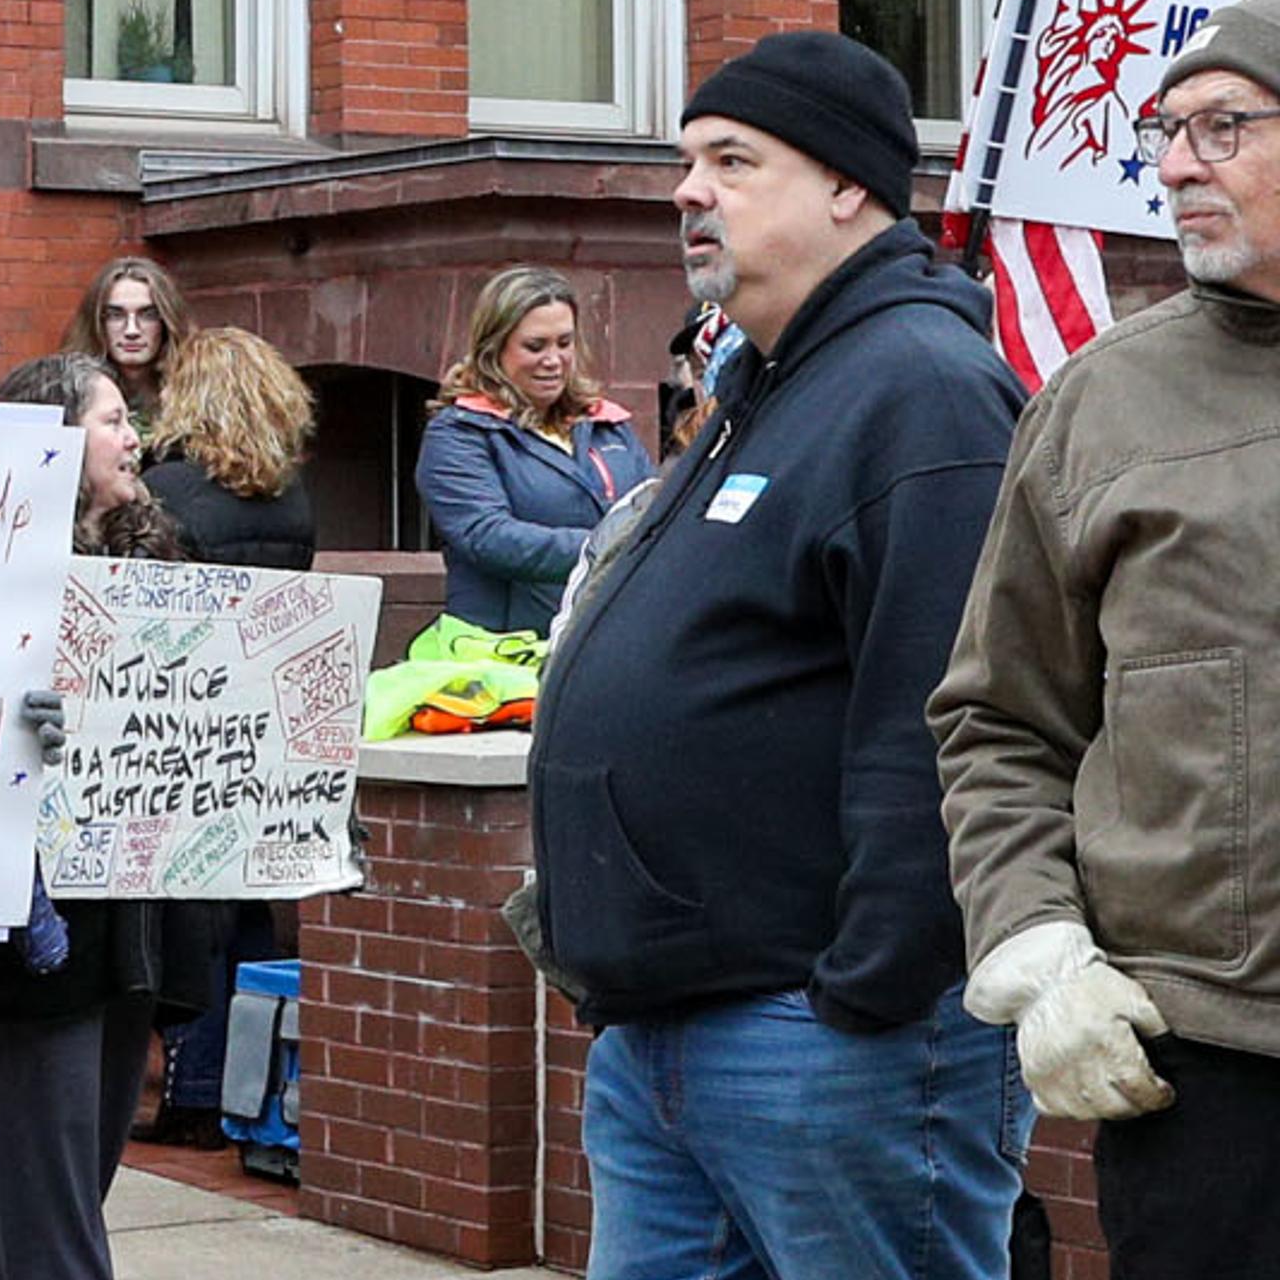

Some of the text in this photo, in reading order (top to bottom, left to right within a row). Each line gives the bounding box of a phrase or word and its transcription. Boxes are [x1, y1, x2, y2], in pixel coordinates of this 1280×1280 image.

[1160, 4, 1211, 58] HE
[104, 584, 131, 608] THE
[197, 567, 251, 593] DEFEND
[88, 654, 228, 703] INJUSTICE
[122, 710, 270, 751] ANYWHERE
[86, 750, 103, 779] A
[110, 742, 213, 780] THREAT
[216, 749, 257, 778] TO
[75, 782, 185, 825] JUSTICE
[192, 770, 347, 818] EVERYWHERE
[75, 829, 111, 855] SAVE
